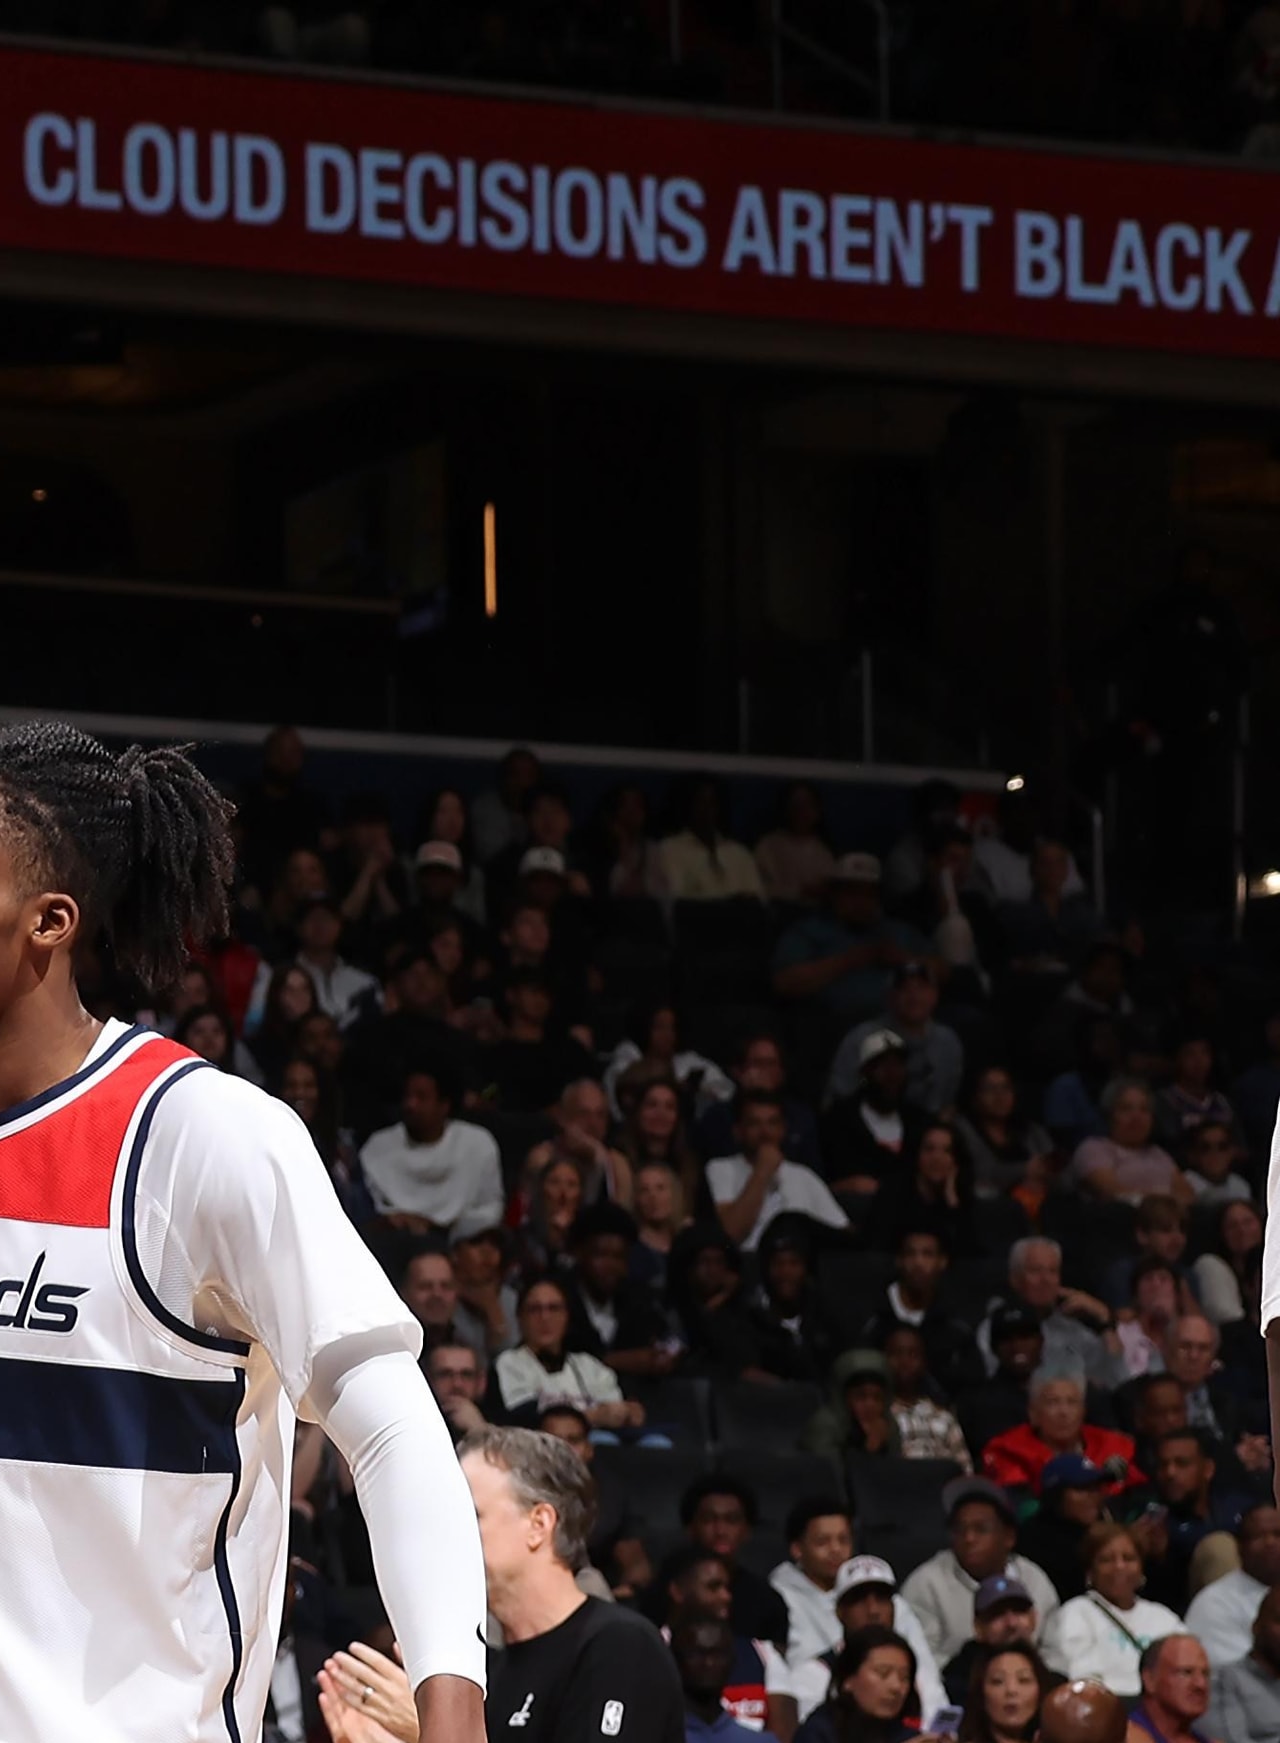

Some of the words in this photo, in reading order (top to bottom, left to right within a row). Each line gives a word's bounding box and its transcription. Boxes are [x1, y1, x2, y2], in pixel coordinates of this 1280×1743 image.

[23, 112, 285, 225] CLOUD
[304, 142, 708, 268] DECISIONS
[1015, 210, 1255, 316] BLACK
